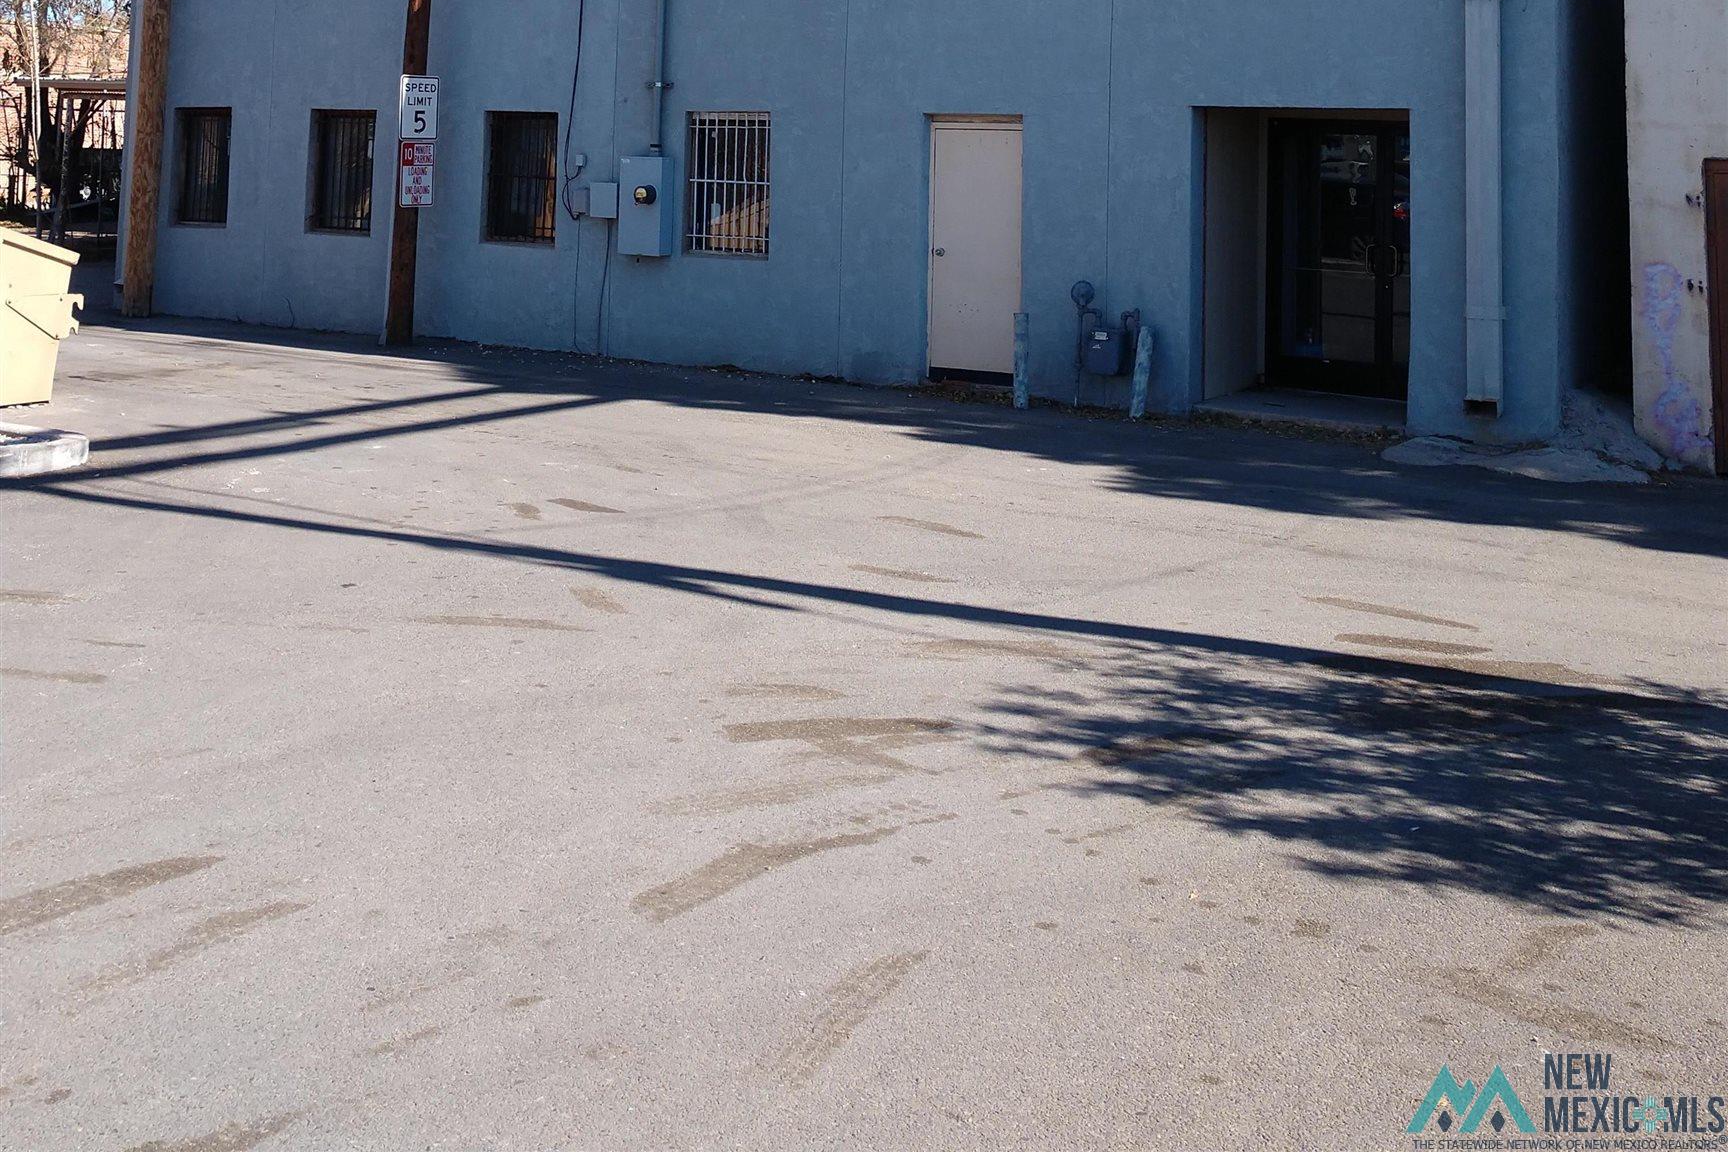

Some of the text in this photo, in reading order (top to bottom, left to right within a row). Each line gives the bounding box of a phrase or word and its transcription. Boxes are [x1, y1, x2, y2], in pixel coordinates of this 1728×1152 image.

[405, 83, 437, 93] SPEED
[407, 97, 432, 106] LIMIT
[413, 110, 426, 134] 5
[404, 148, 413, 160] 10
[414, 155, 433, 164] PARKING
[408, 167, 428, 175] LOADING
[412, 177, 422, 185] AND
[404, 186, 430, 195] UNLOADING
[410, 195, 422, 204] ONLY
